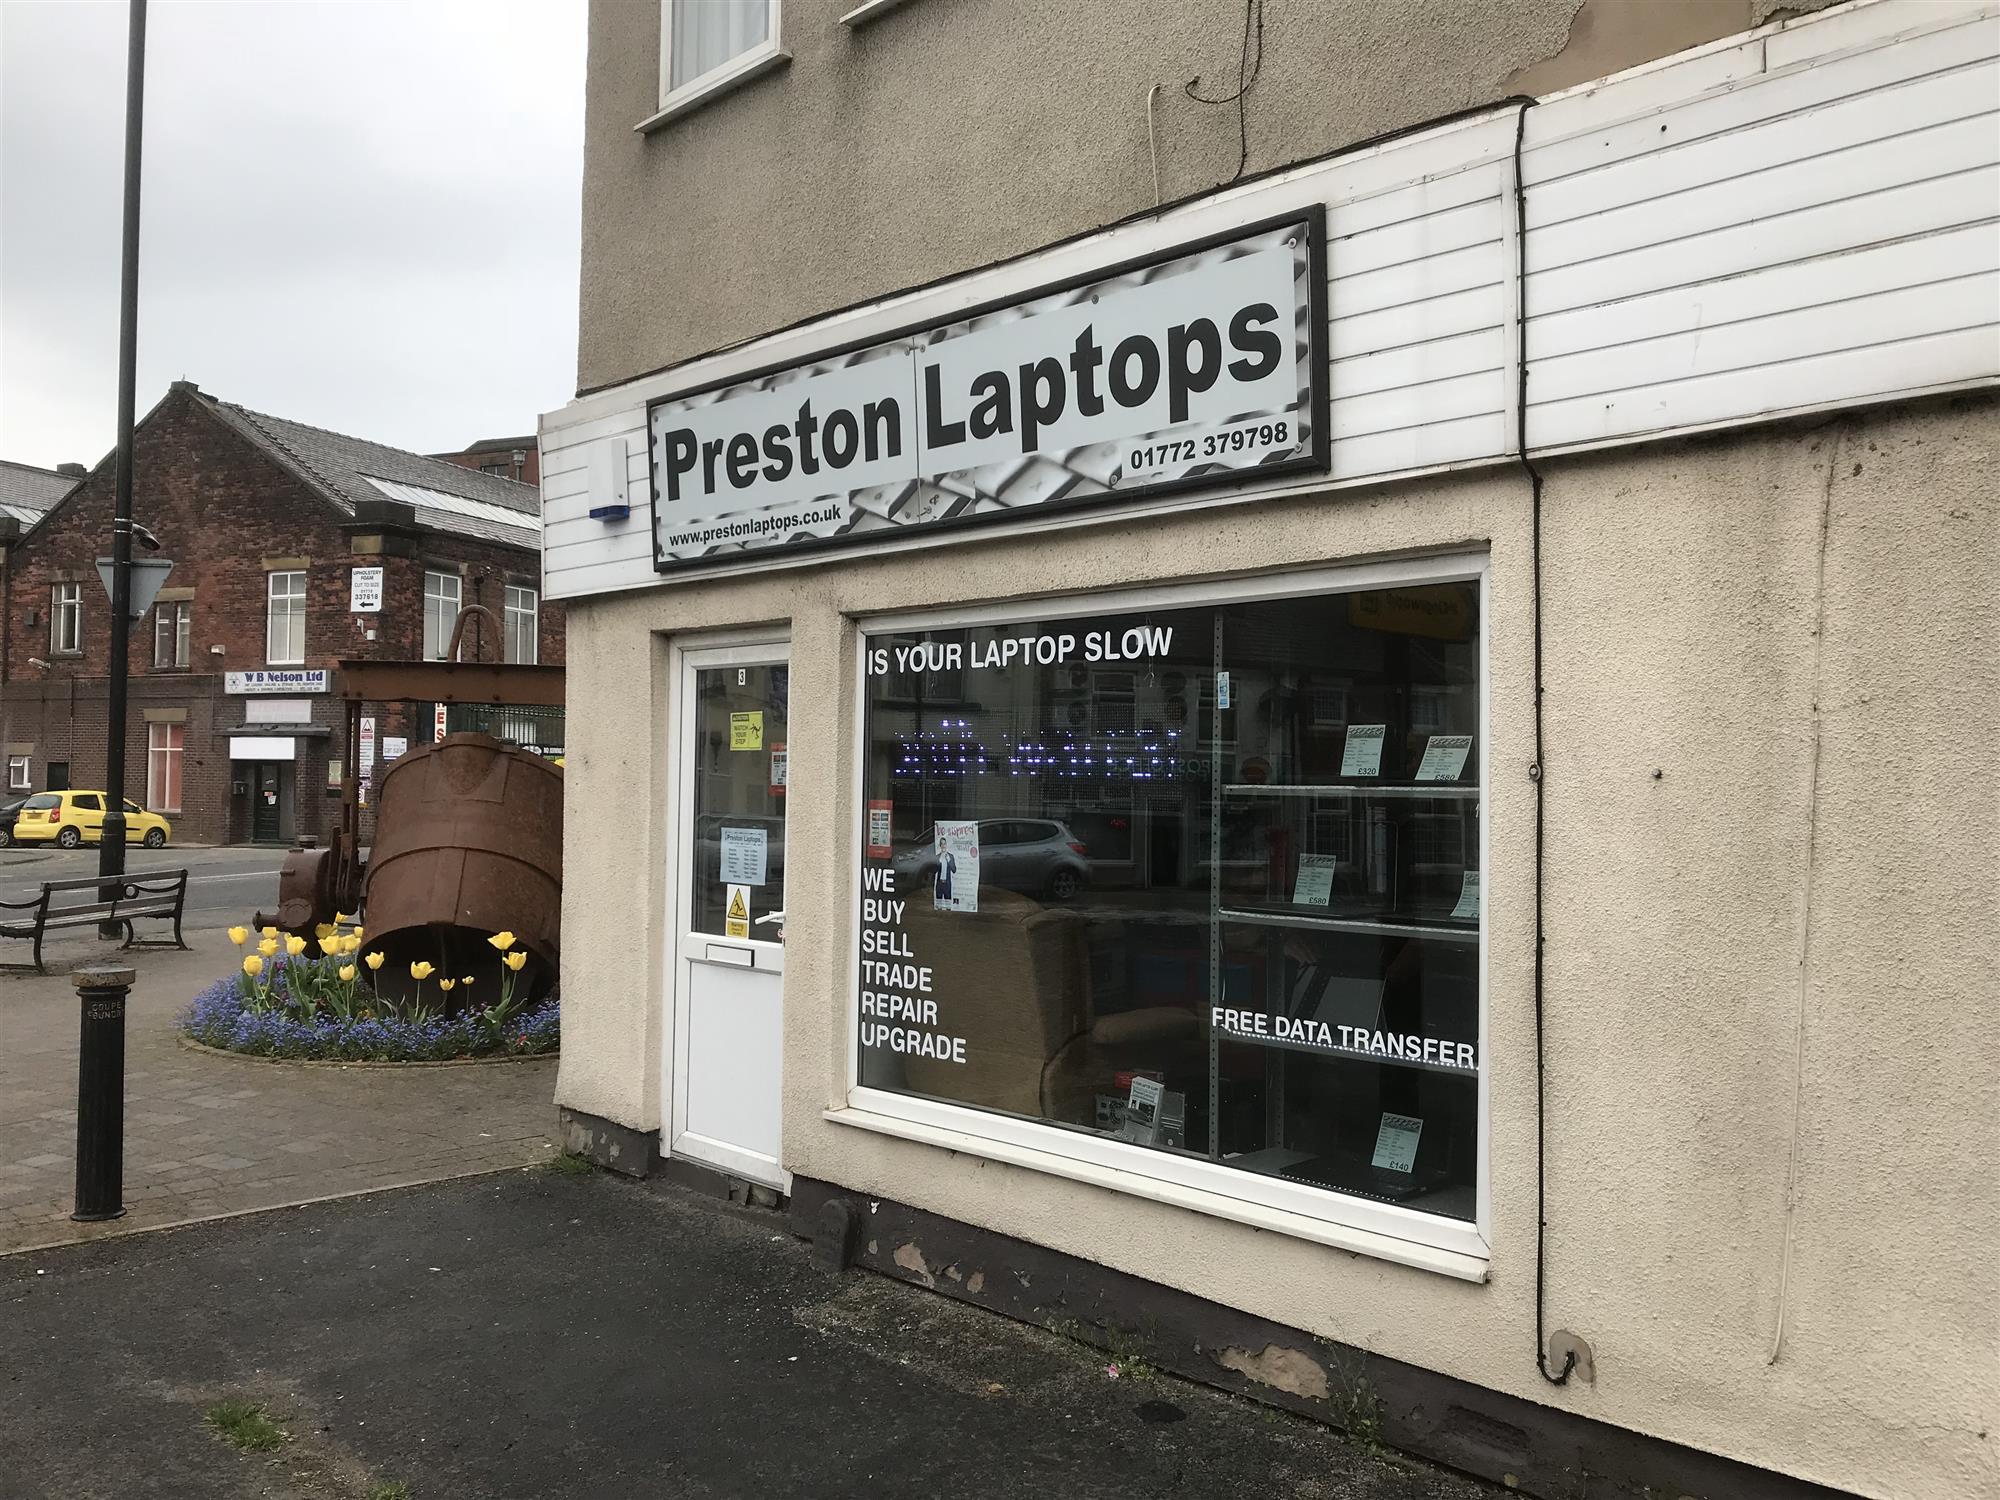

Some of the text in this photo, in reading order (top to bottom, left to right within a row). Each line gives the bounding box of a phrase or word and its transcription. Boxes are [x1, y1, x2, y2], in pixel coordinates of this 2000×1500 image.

[664, 302, 1283, 501] Preston Laptops
[1129, 421, 1289, 471] 01772 379798
[669, 505, 841, 547] www.prestonlaptops.co.uk
[867, 626, 1174, 676] IS YOUR LAPTOP SLOW
[244, 671, 324, 682] W B Nelson Ltd
[1357, 767, 1377, 776] £320
[863, 867, 896, 893] WE
[862, 900, 906, 925] BUY
[862, 931, 914, 958] SELL
[862, 960, 933, 993] TRADE
[861, 994, 938, 1027] REPAIR
[861, 1024, 967, 1064] UPGRADE
[1212, 1007, 1475, 1070] FREE DATA TRANSFER
[1389, 1160, 1409, 1172] £140
